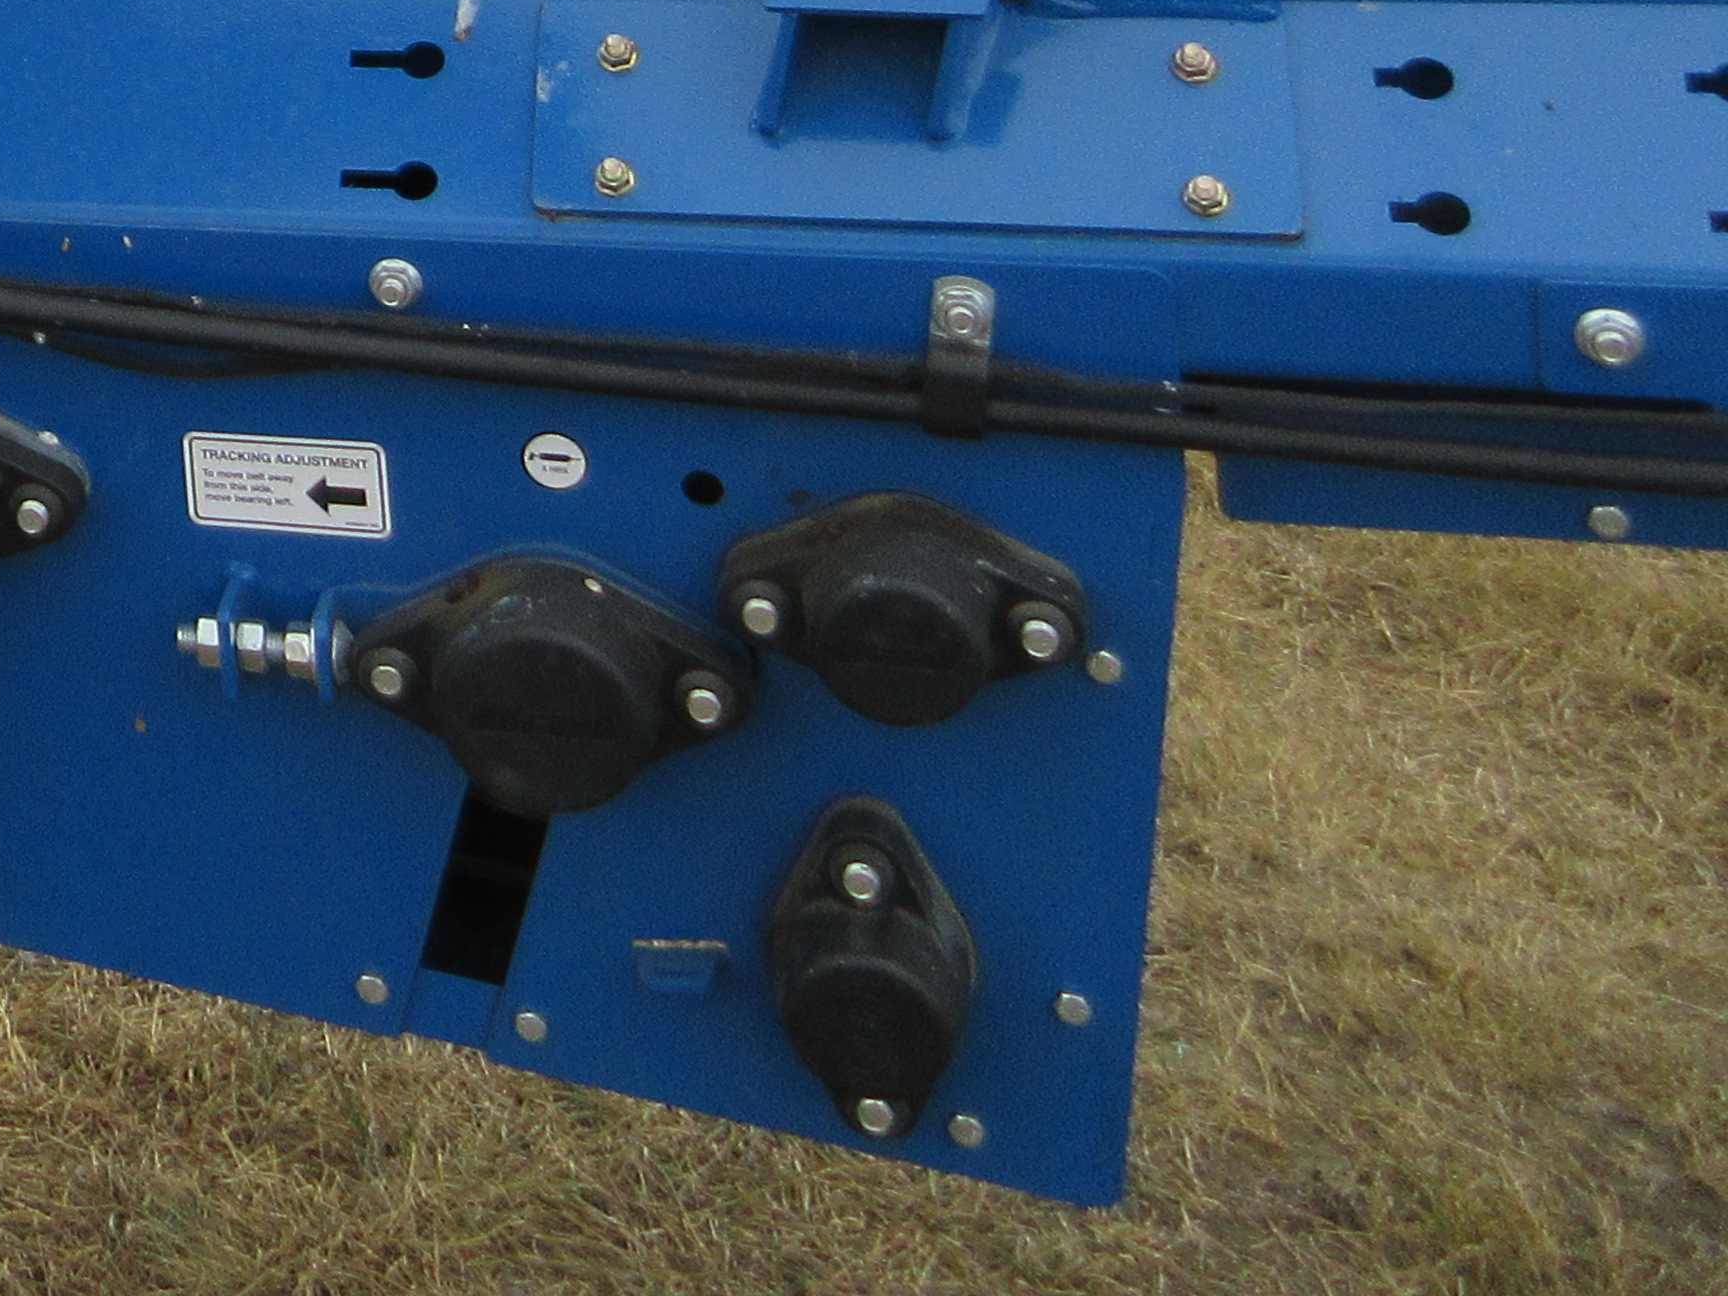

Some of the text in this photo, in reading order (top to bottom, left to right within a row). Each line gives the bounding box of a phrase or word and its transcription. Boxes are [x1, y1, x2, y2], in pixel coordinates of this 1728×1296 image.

[201, 448, 368, 470] TRACKING ADJUSTMENT
[202, 468, 215, 478] To
[216, 470, 244, 479] move
[267, 474, 294, 484] away
[233, 494, 273, 506] bearing
